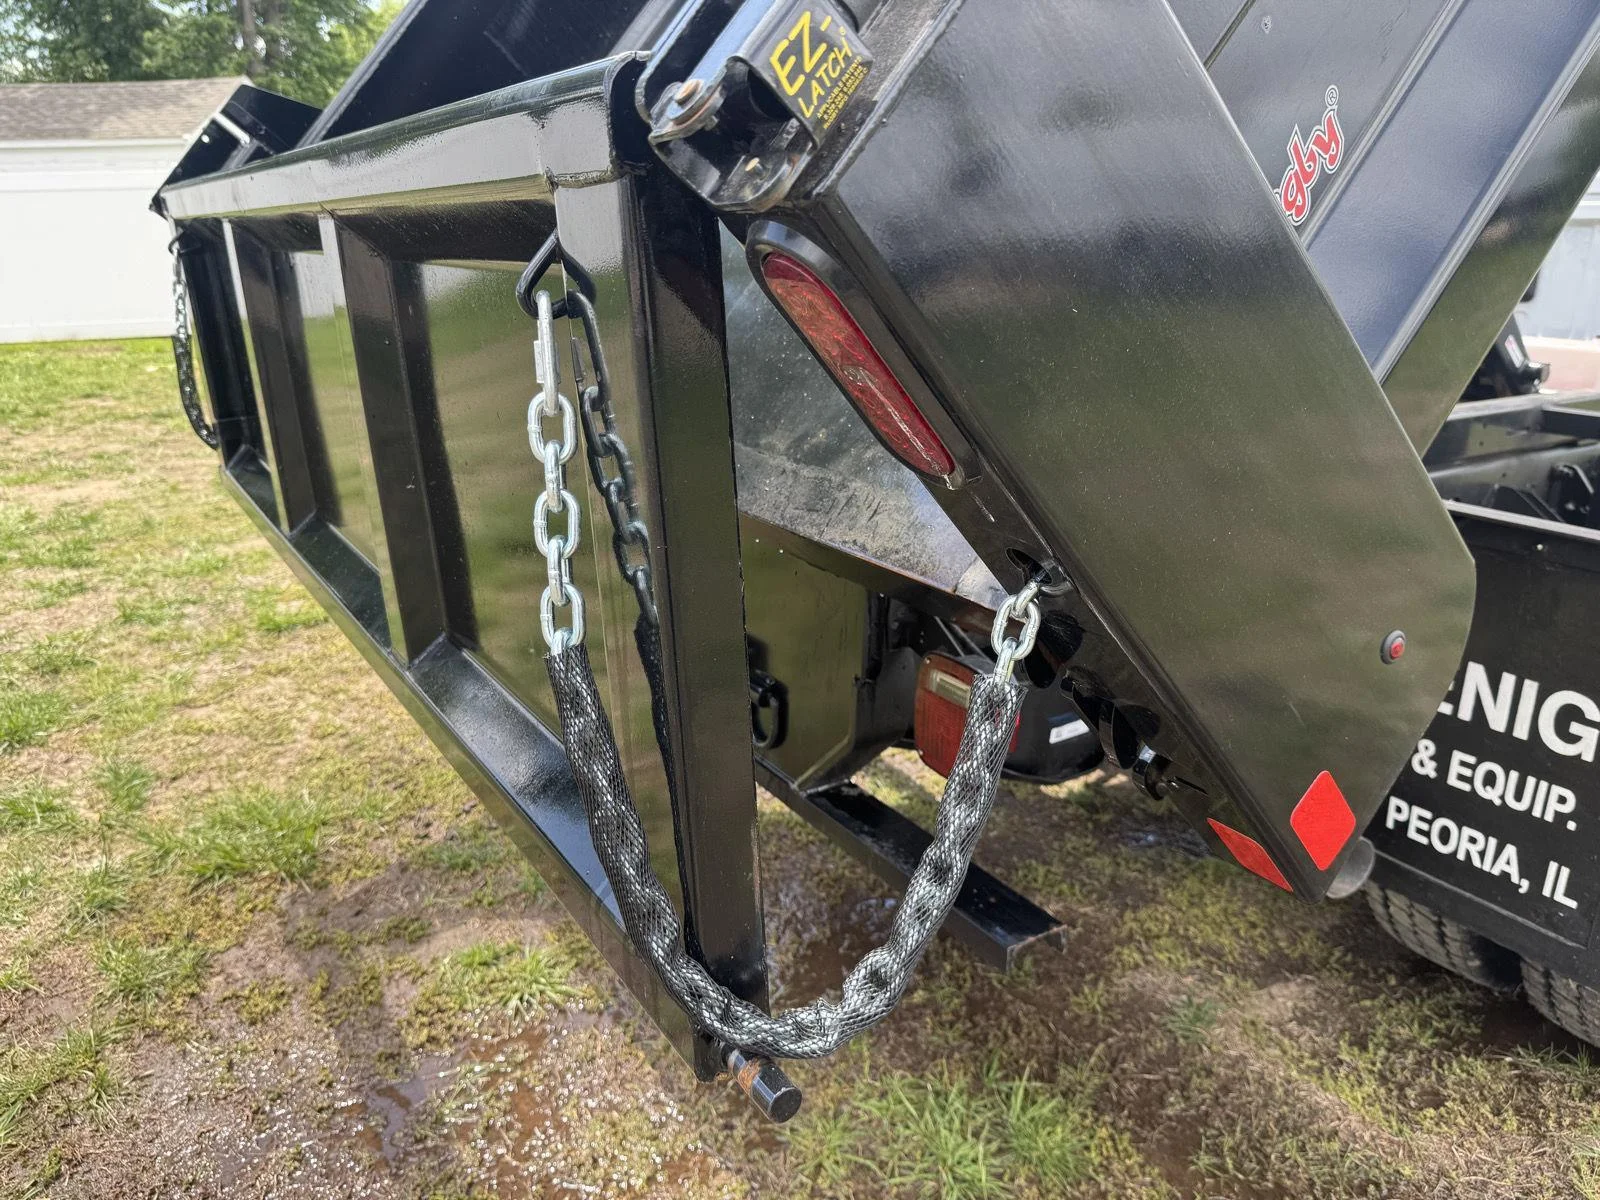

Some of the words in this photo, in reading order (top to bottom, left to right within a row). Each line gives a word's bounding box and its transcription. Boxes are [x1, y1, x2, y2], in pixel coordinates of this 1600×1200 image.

[770, 11, 832, 95] EZ-
[1274, 109, 1344, 225] gby
[1411, 739, 1438, 779] &
[1447, 749, 1577, 831] EQUIP.
[1386, 796, 1530, 894] PEORIA,
[1542, 860, 1578, 909] IL
